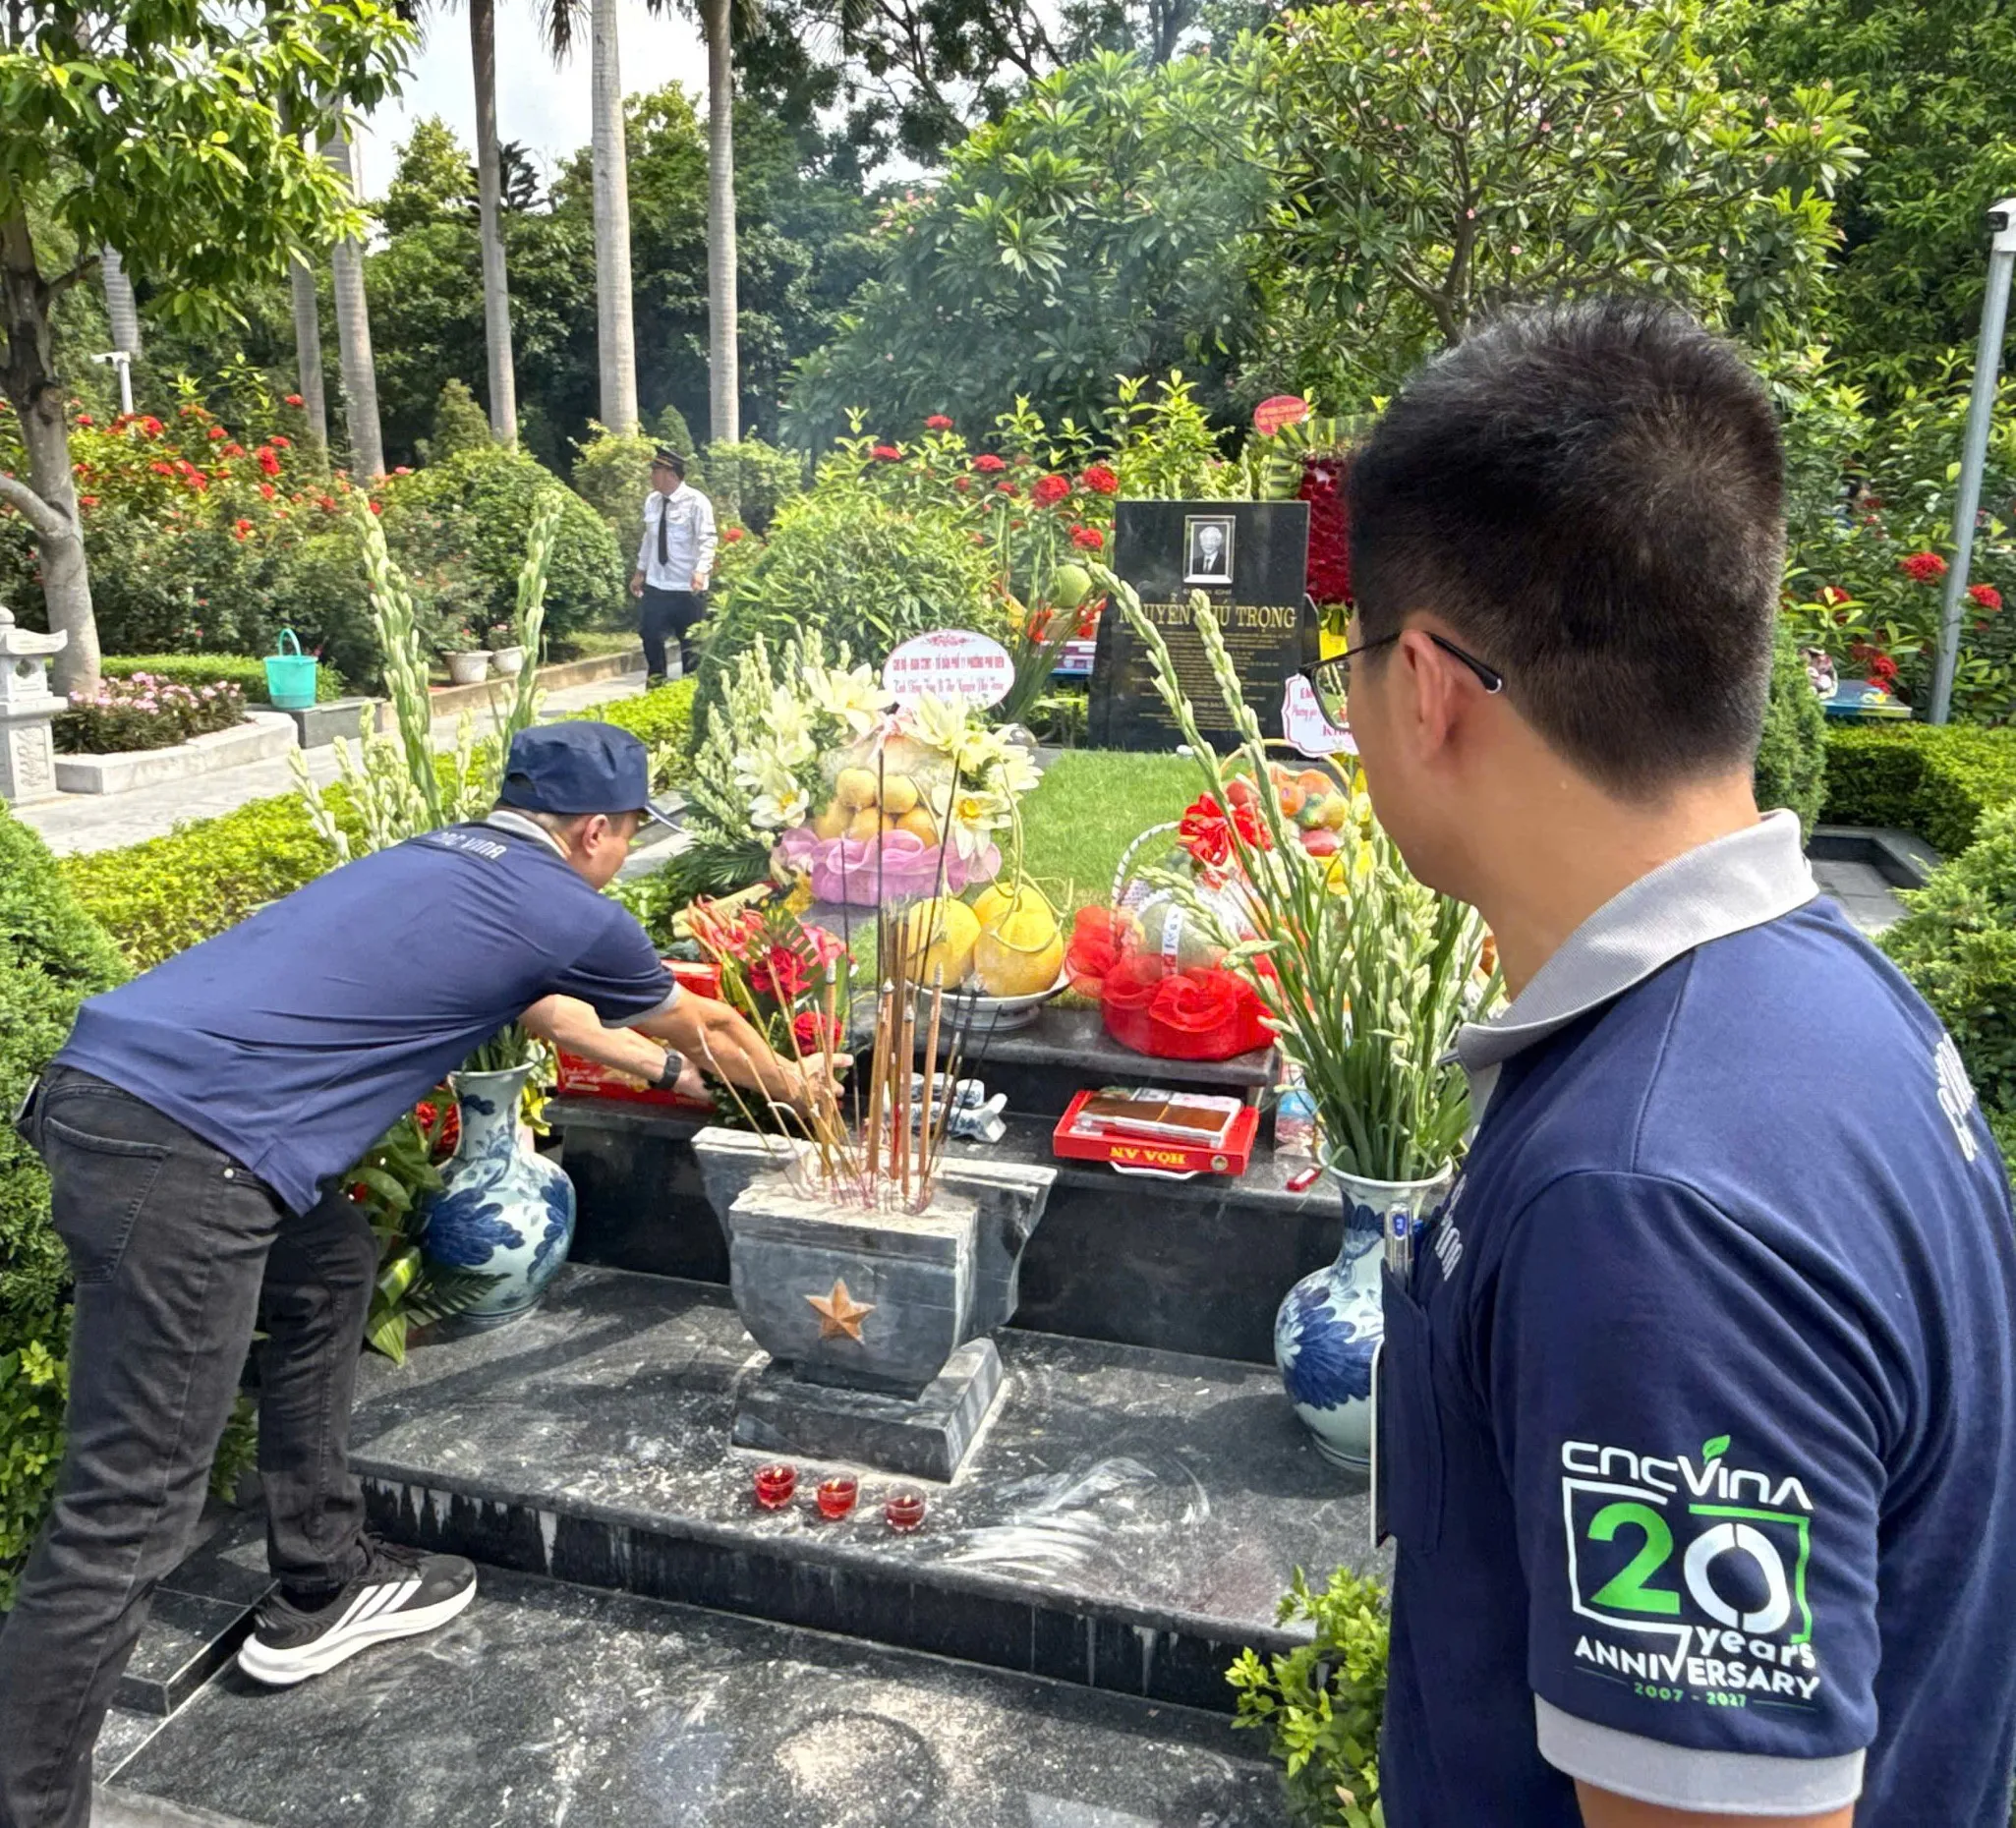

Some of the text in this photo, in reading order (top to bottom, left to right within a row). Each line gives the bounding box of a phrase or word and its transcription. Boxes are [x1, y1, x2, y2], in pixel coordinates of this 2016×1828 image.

[1236, 604, 1297, 633] TRỌNG
[1110, 1145, 1140, 1161] AN
[1586, 1501, 1792, 1634] 20
[1693, 1626, 1817, 1670] years
[1574, 1633, 1821, 1701] ANNIVERSARY
[1634, 1682, 1684, 1703] 2007
